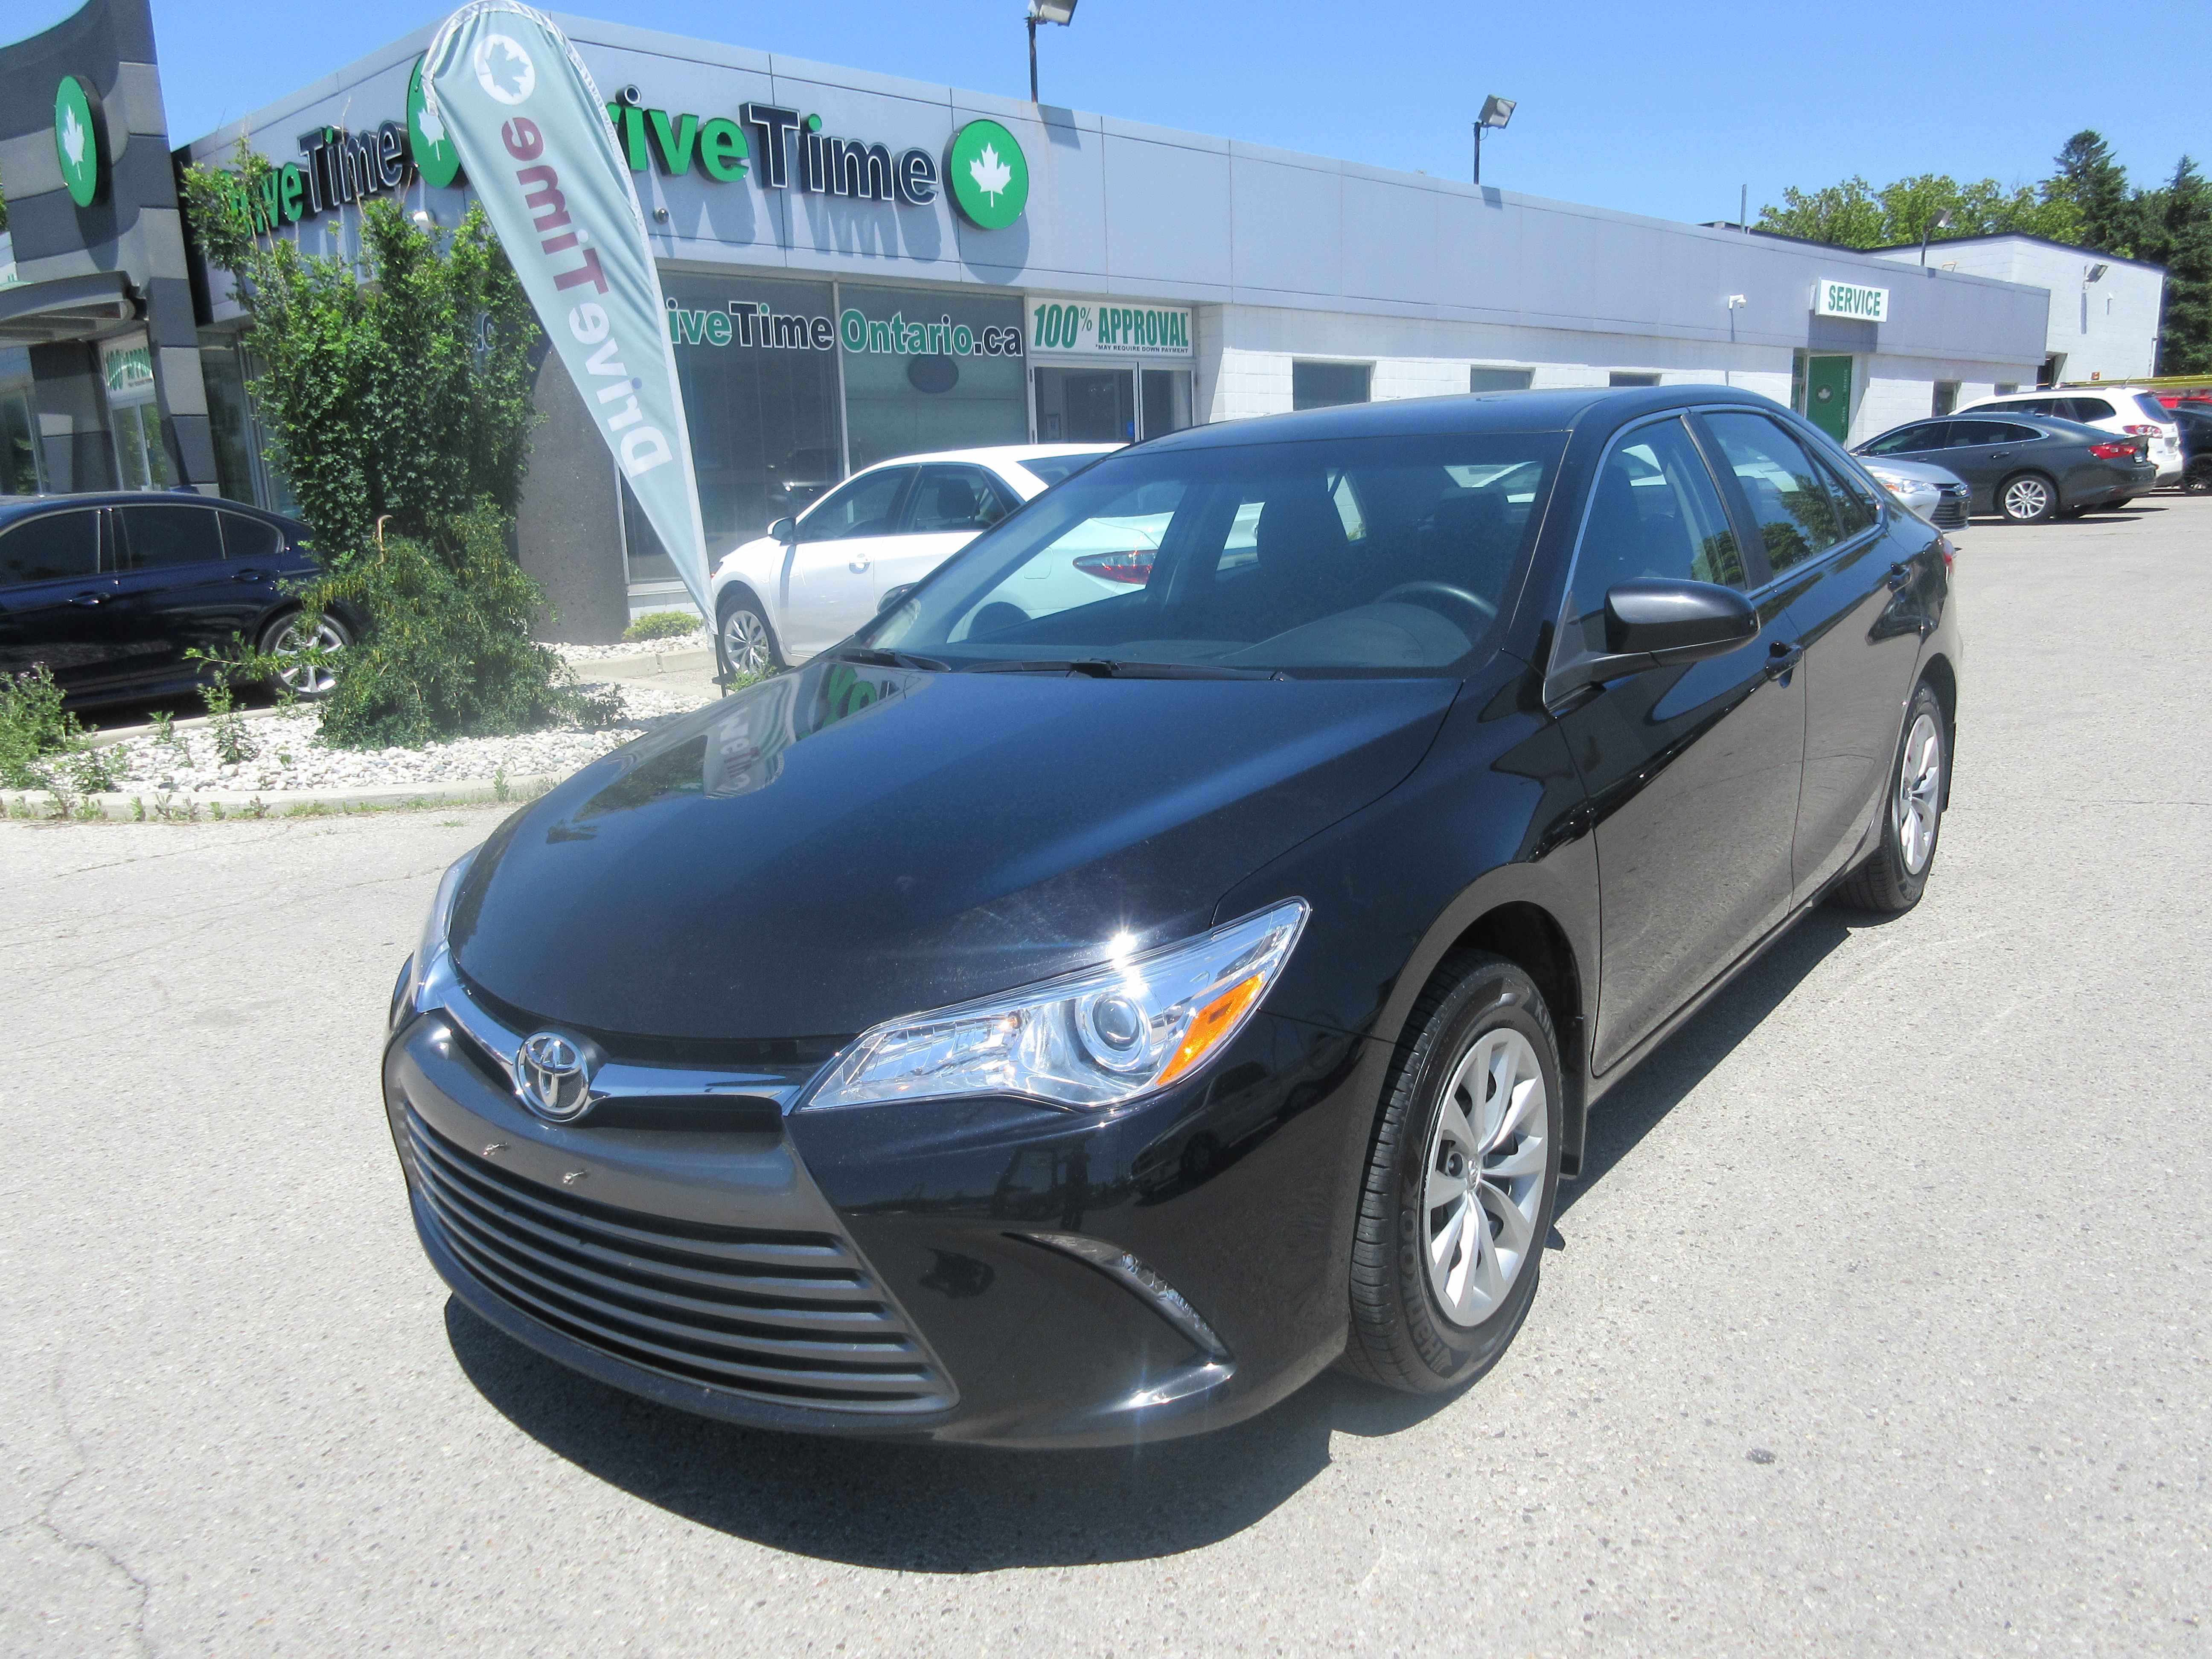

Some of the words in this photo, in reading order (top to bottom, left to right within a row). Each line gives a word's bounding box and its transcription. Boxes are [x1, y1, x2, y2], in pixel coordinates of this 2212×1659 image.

[606, 84, 938, 206] iveTime
[1828, 285, 1881, 316] SERVICE
[1034, 304, 1092, 348] 100%
